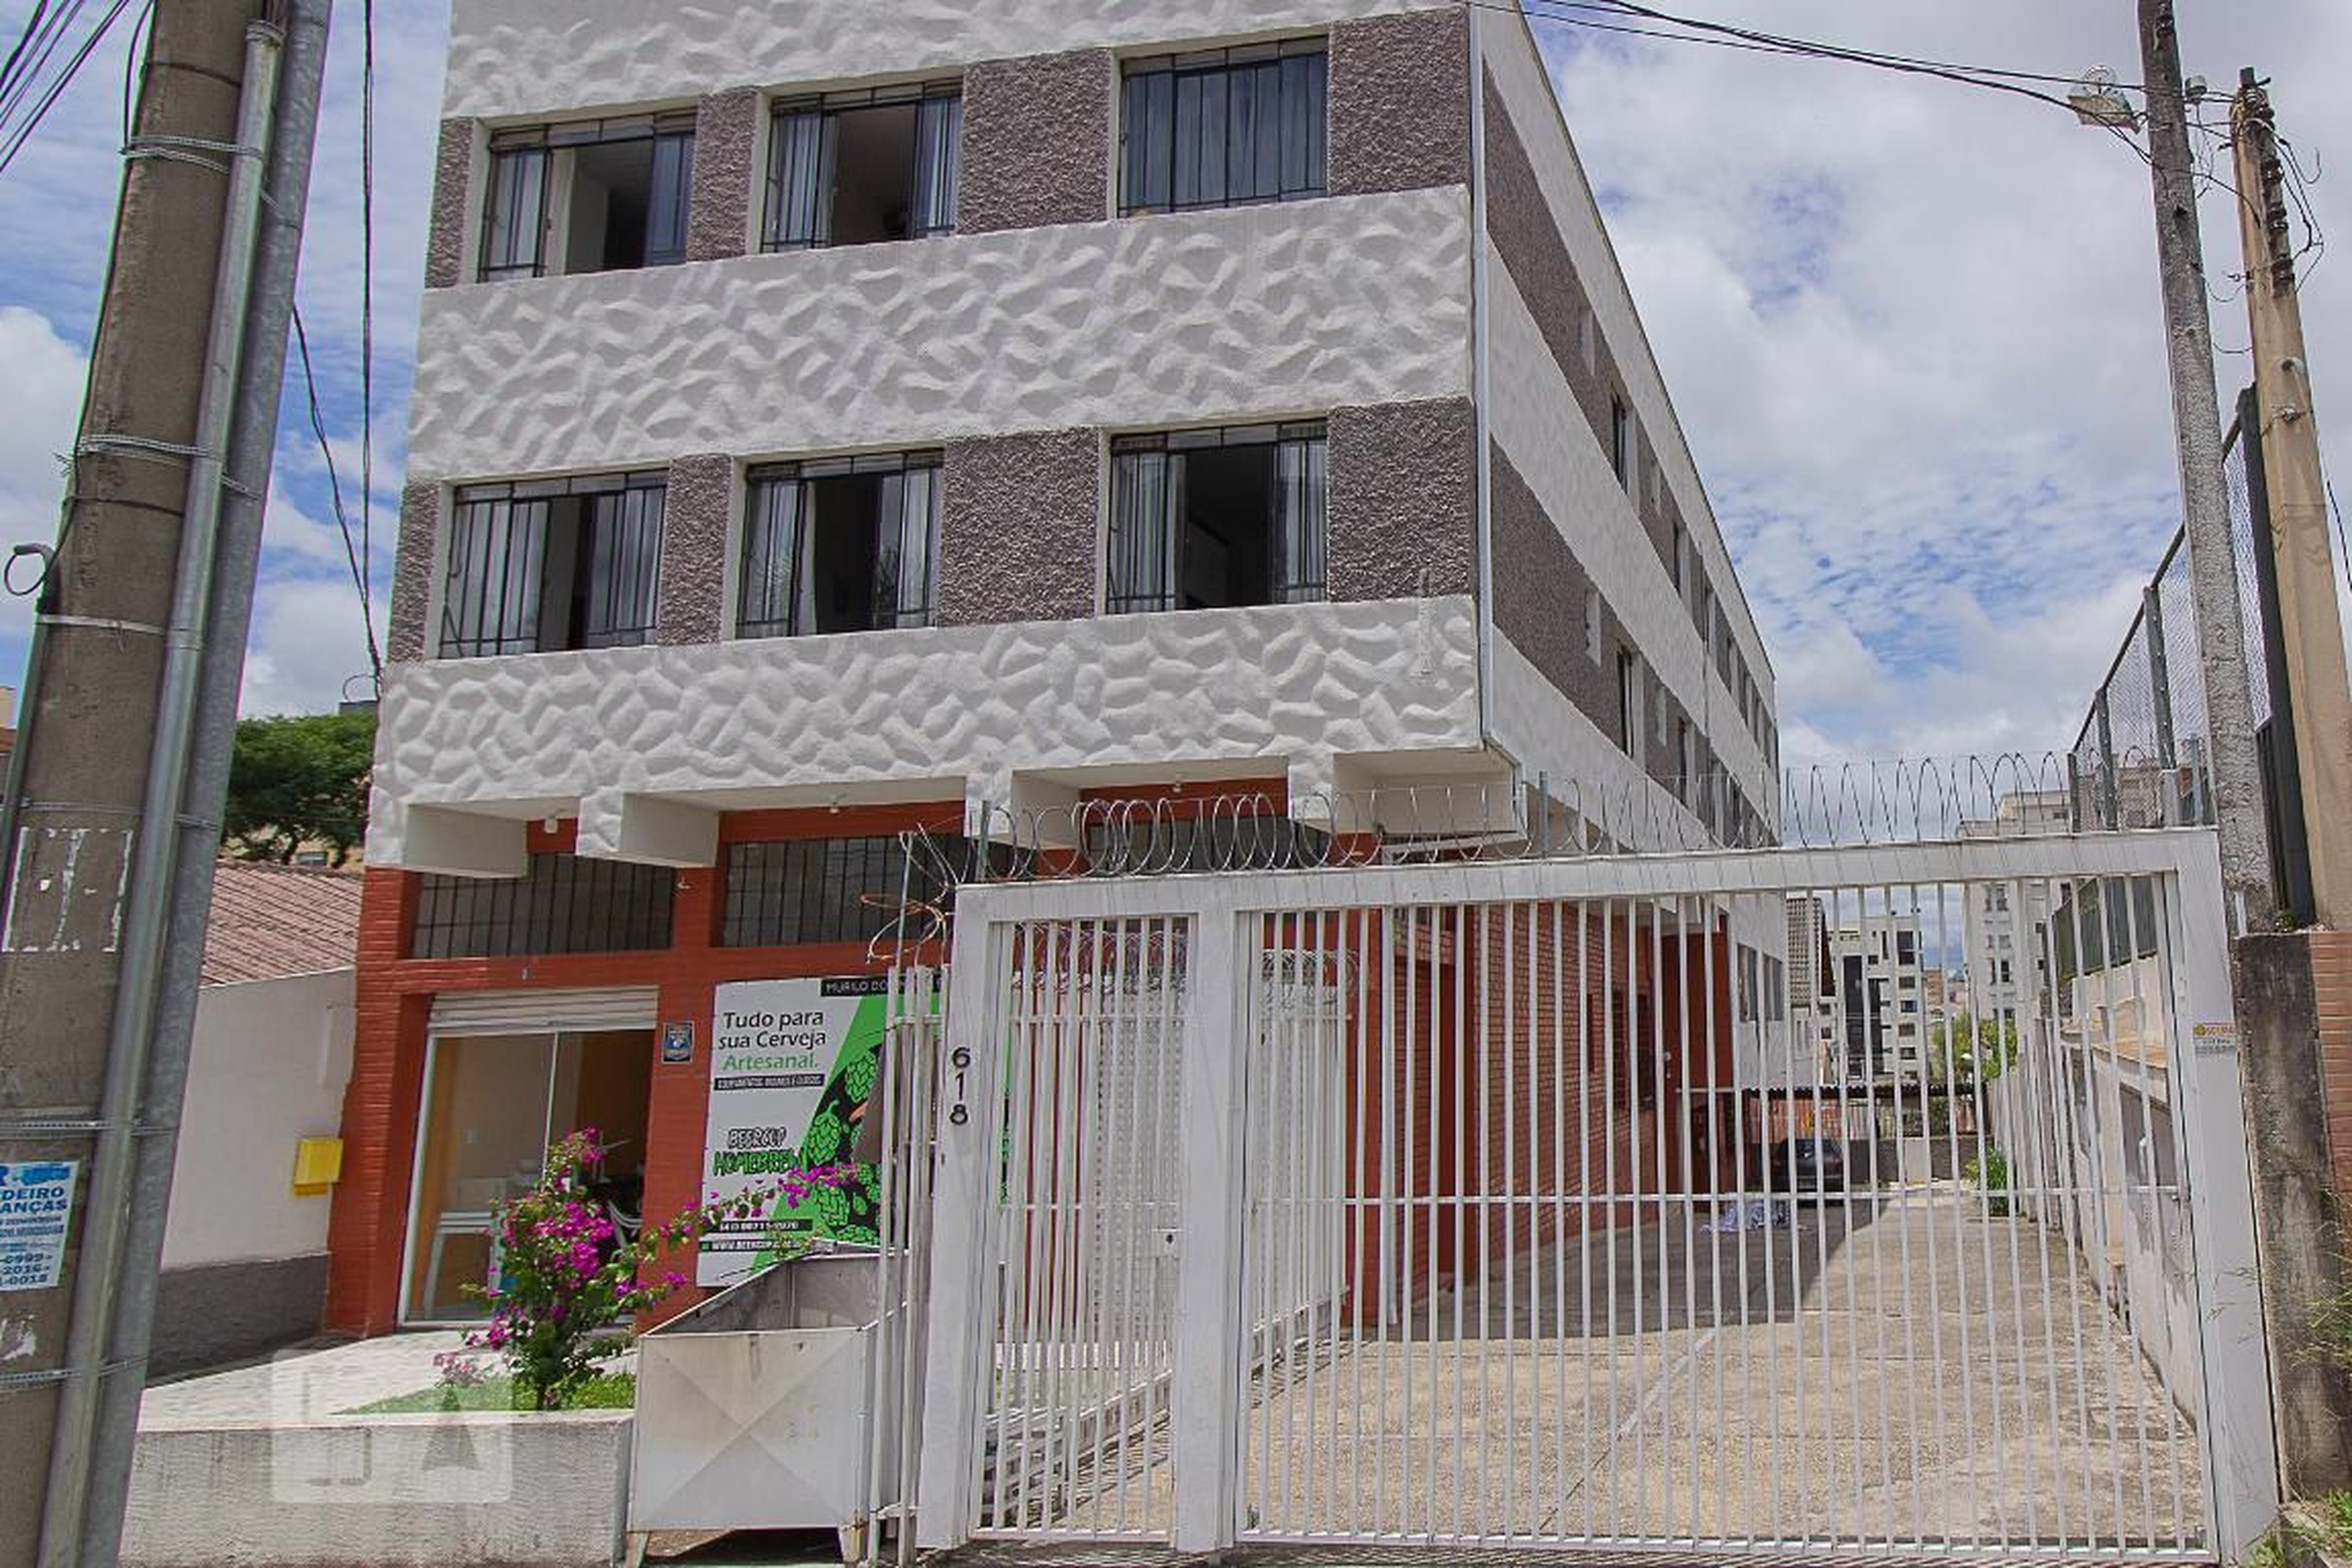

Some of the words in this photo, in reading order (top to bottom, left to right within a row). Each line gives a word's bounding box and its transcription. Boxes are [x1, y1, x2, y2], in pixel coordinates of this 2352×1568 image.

[723, 1012, 774, 1029] Tudo
[779, 1012, 824, 1031] para
[718, 1035, 750, 1050] sua
[756, 1029, 826, 1050] Cerveja
[722, 1052, 819, 1071] Artesanal.
[949, 1047, 971, 1126] 618
